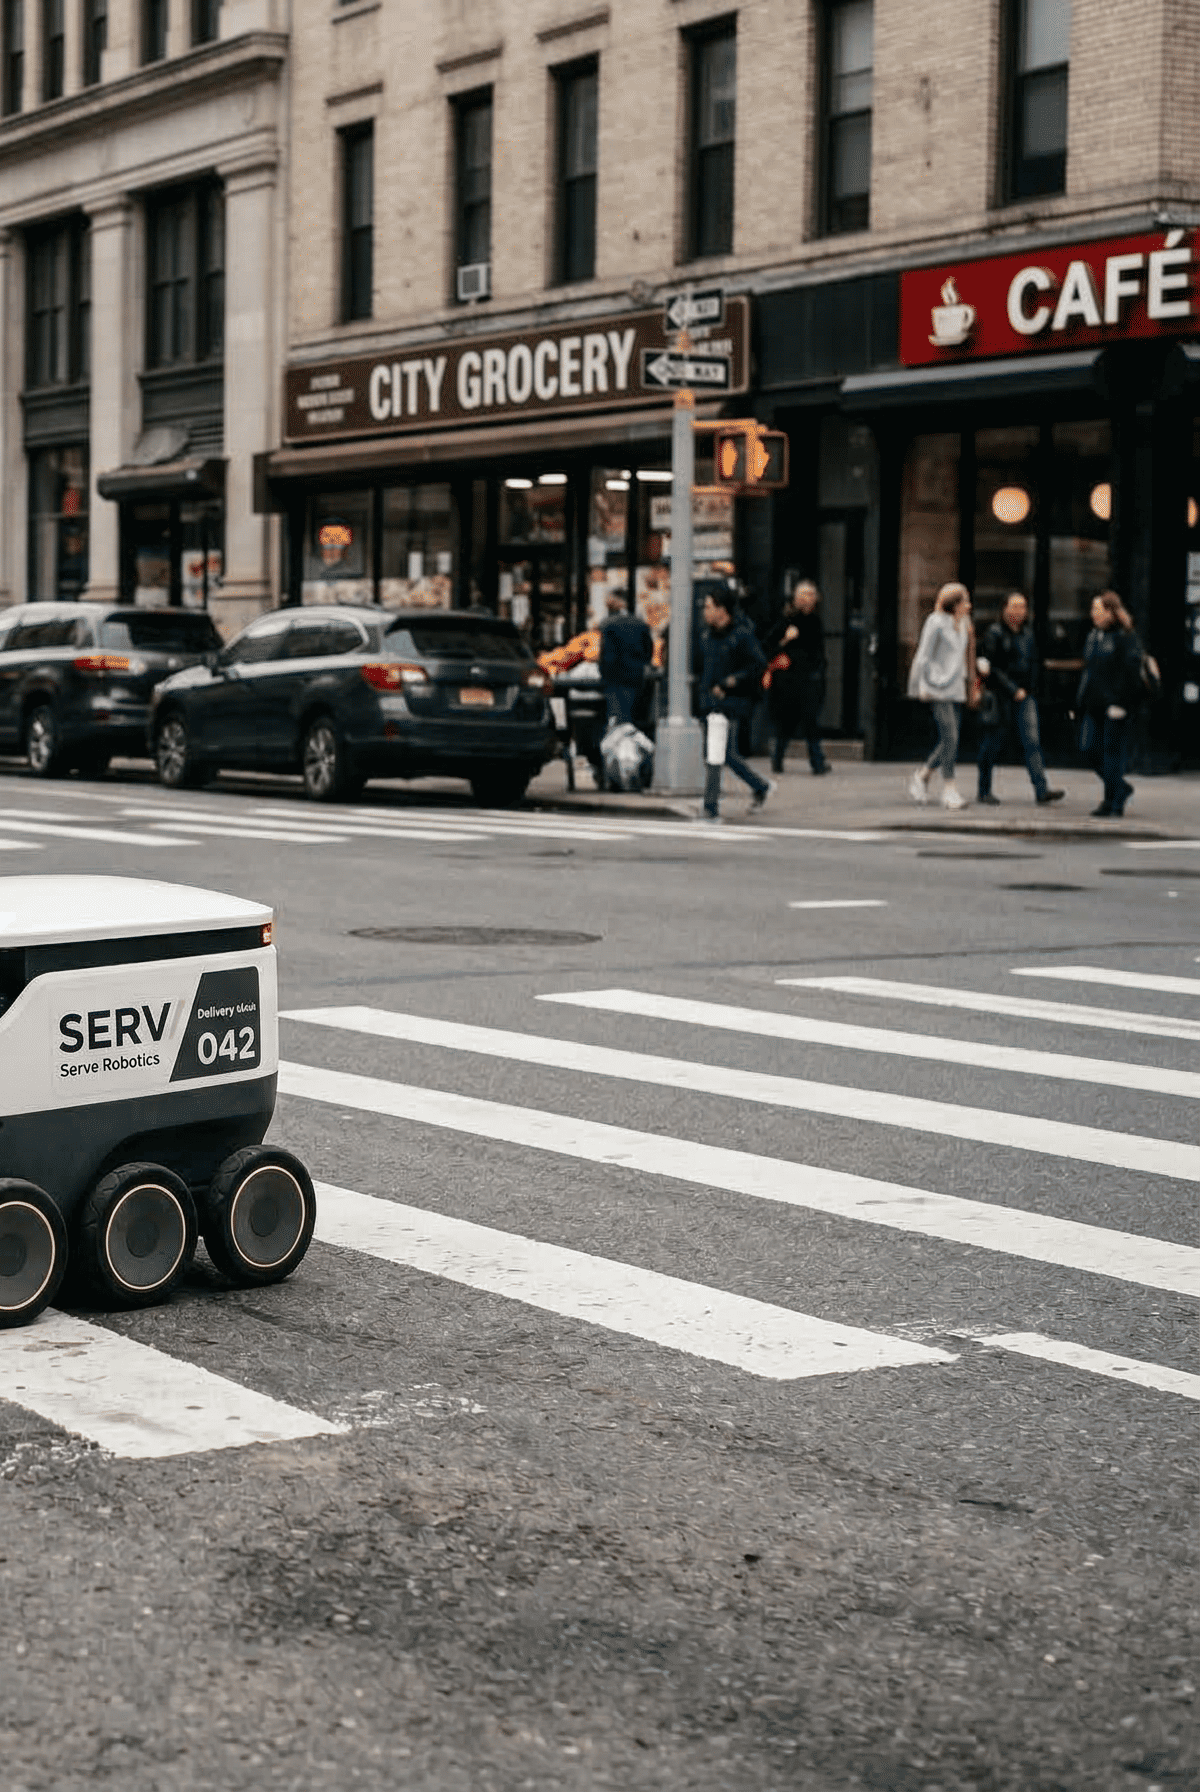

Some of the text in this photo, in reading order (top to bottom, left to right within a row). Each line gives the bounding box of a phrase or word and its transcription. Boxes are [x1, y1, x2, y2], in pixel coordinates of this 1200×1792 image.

[1007, 229, 1192, 335] CAFÉ
[369, 328, 637, 421] CITY GROCERY
[58, 1002, 172, 1053] SERV
[197, 1005, 235, 1019] Delivery
[60, 1053, 160, 1077] Serve Robotics
[197, 1026, 256, 1065] 042
